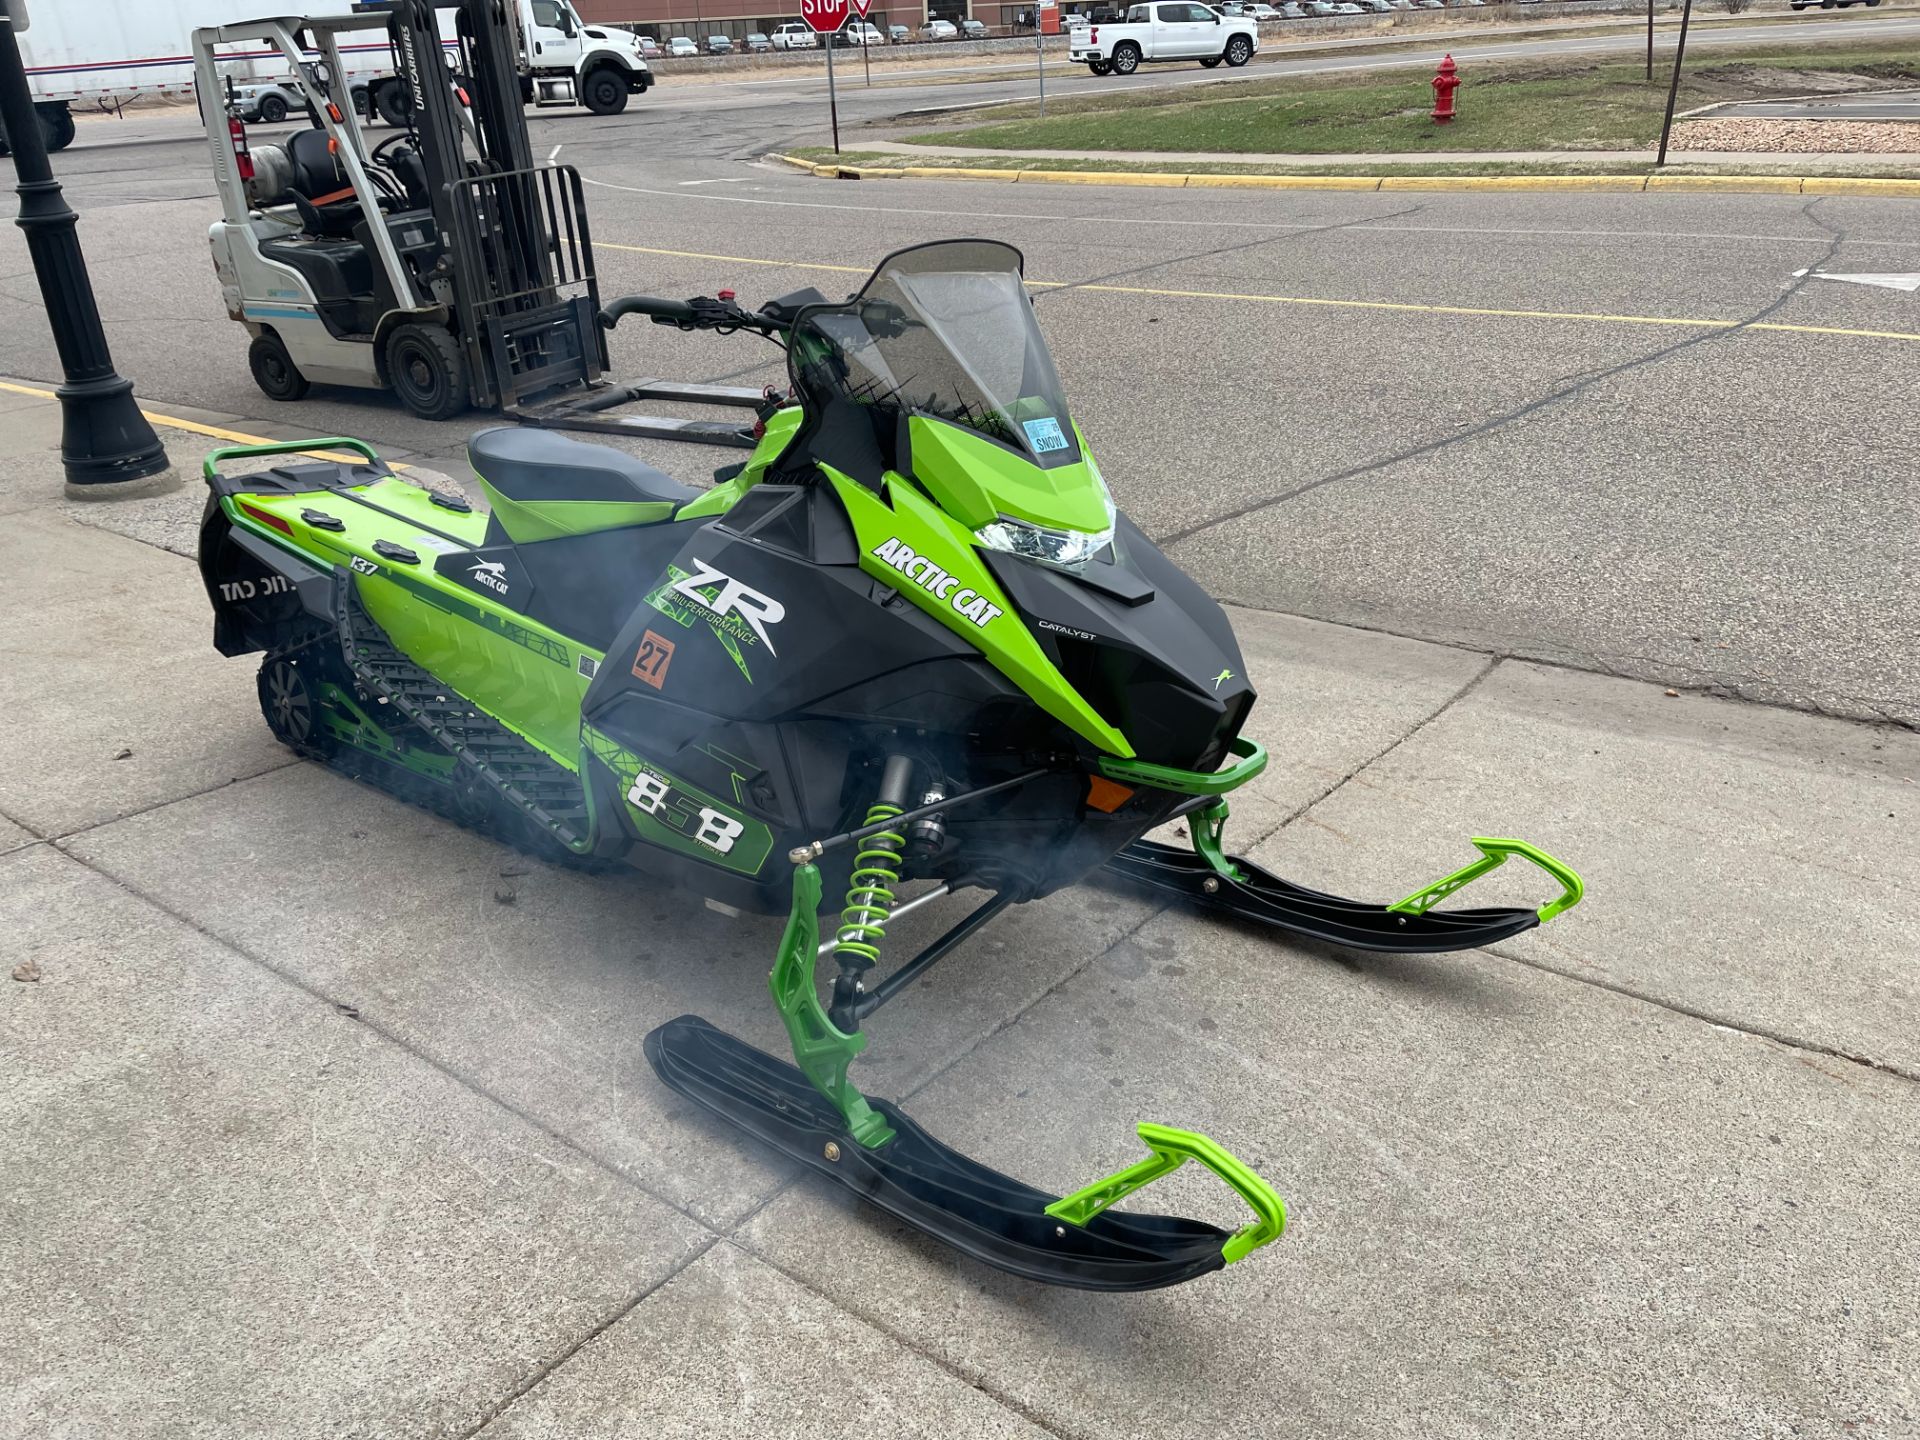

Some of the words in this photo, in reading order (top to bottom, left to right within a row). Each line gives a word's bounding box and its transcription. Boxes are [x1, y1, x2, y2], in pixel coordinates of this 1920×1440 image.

[804, 0, 845, 14] STOP
[1036, 435, 1063, 451] SNOW
[350, 555, 378, 576] 137
[474, 570, 497, 589] ARCTIC
[496, 581, 509, 595] CAT
[871, 536, 961, 600] ARCTIC
[951, 588, 1004, 628] CAT
[672, 556, 786, 658] ZR
[687, 601, 759, 647] PERFORMANCE
[1038, 620, 1097, 641] CATALYST
[636, 640, 669, 677] 27
[627, 771, 745, 854] 858
